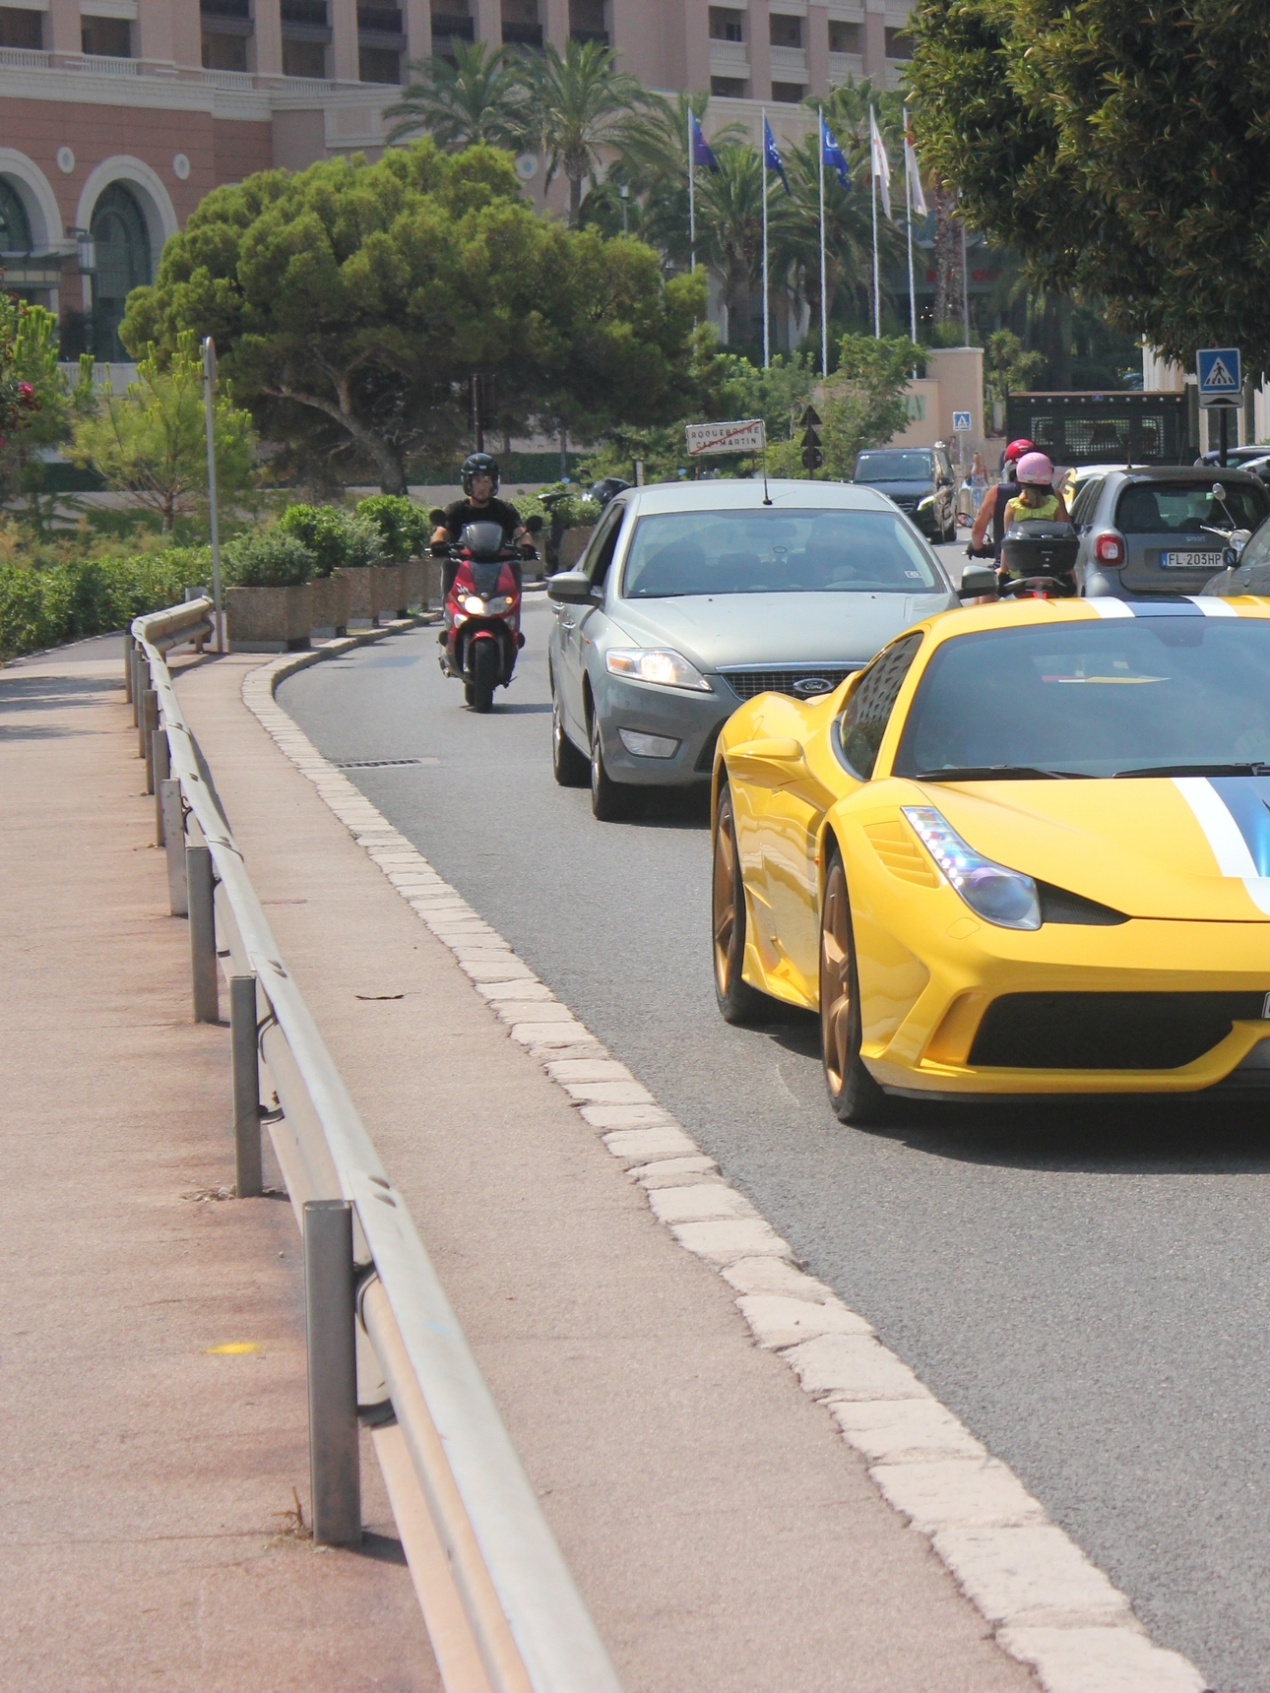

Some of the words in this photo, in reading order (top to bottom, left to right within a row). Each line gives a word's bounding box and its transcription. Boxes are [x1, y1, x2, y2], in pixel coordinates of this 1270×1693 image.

[691, 426, 760, 439] ROQUEBRUNE
[1168, 553, 1183, 565] FL
[1186, 553, 1222, 566] 203HP
[804, 681, 823, 690] Ford
